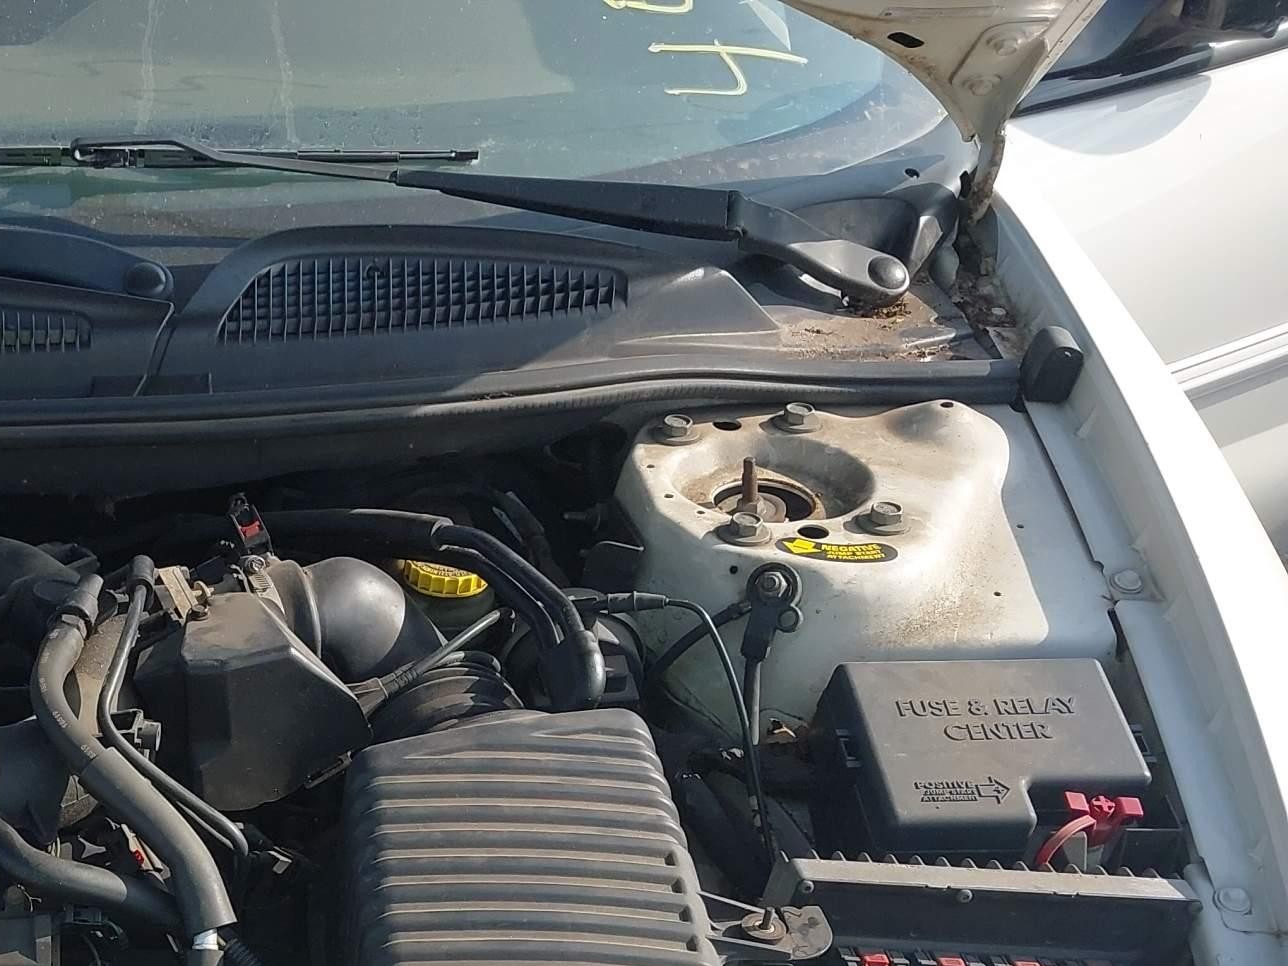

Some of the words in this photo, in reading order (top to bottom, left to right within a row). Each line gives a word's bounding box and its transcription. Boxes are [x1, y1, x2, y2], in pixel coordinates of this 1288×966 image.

[821, 544, 881, 552] NEGATIVE
[895, 699, 962, 717] FUSE
[967, 699, 989, 716] &
[993, 697, 1075, 716] RELAY
[943, 721, 1054, 742] CENTER
[913, 780, 975, 790] POSITIVE
